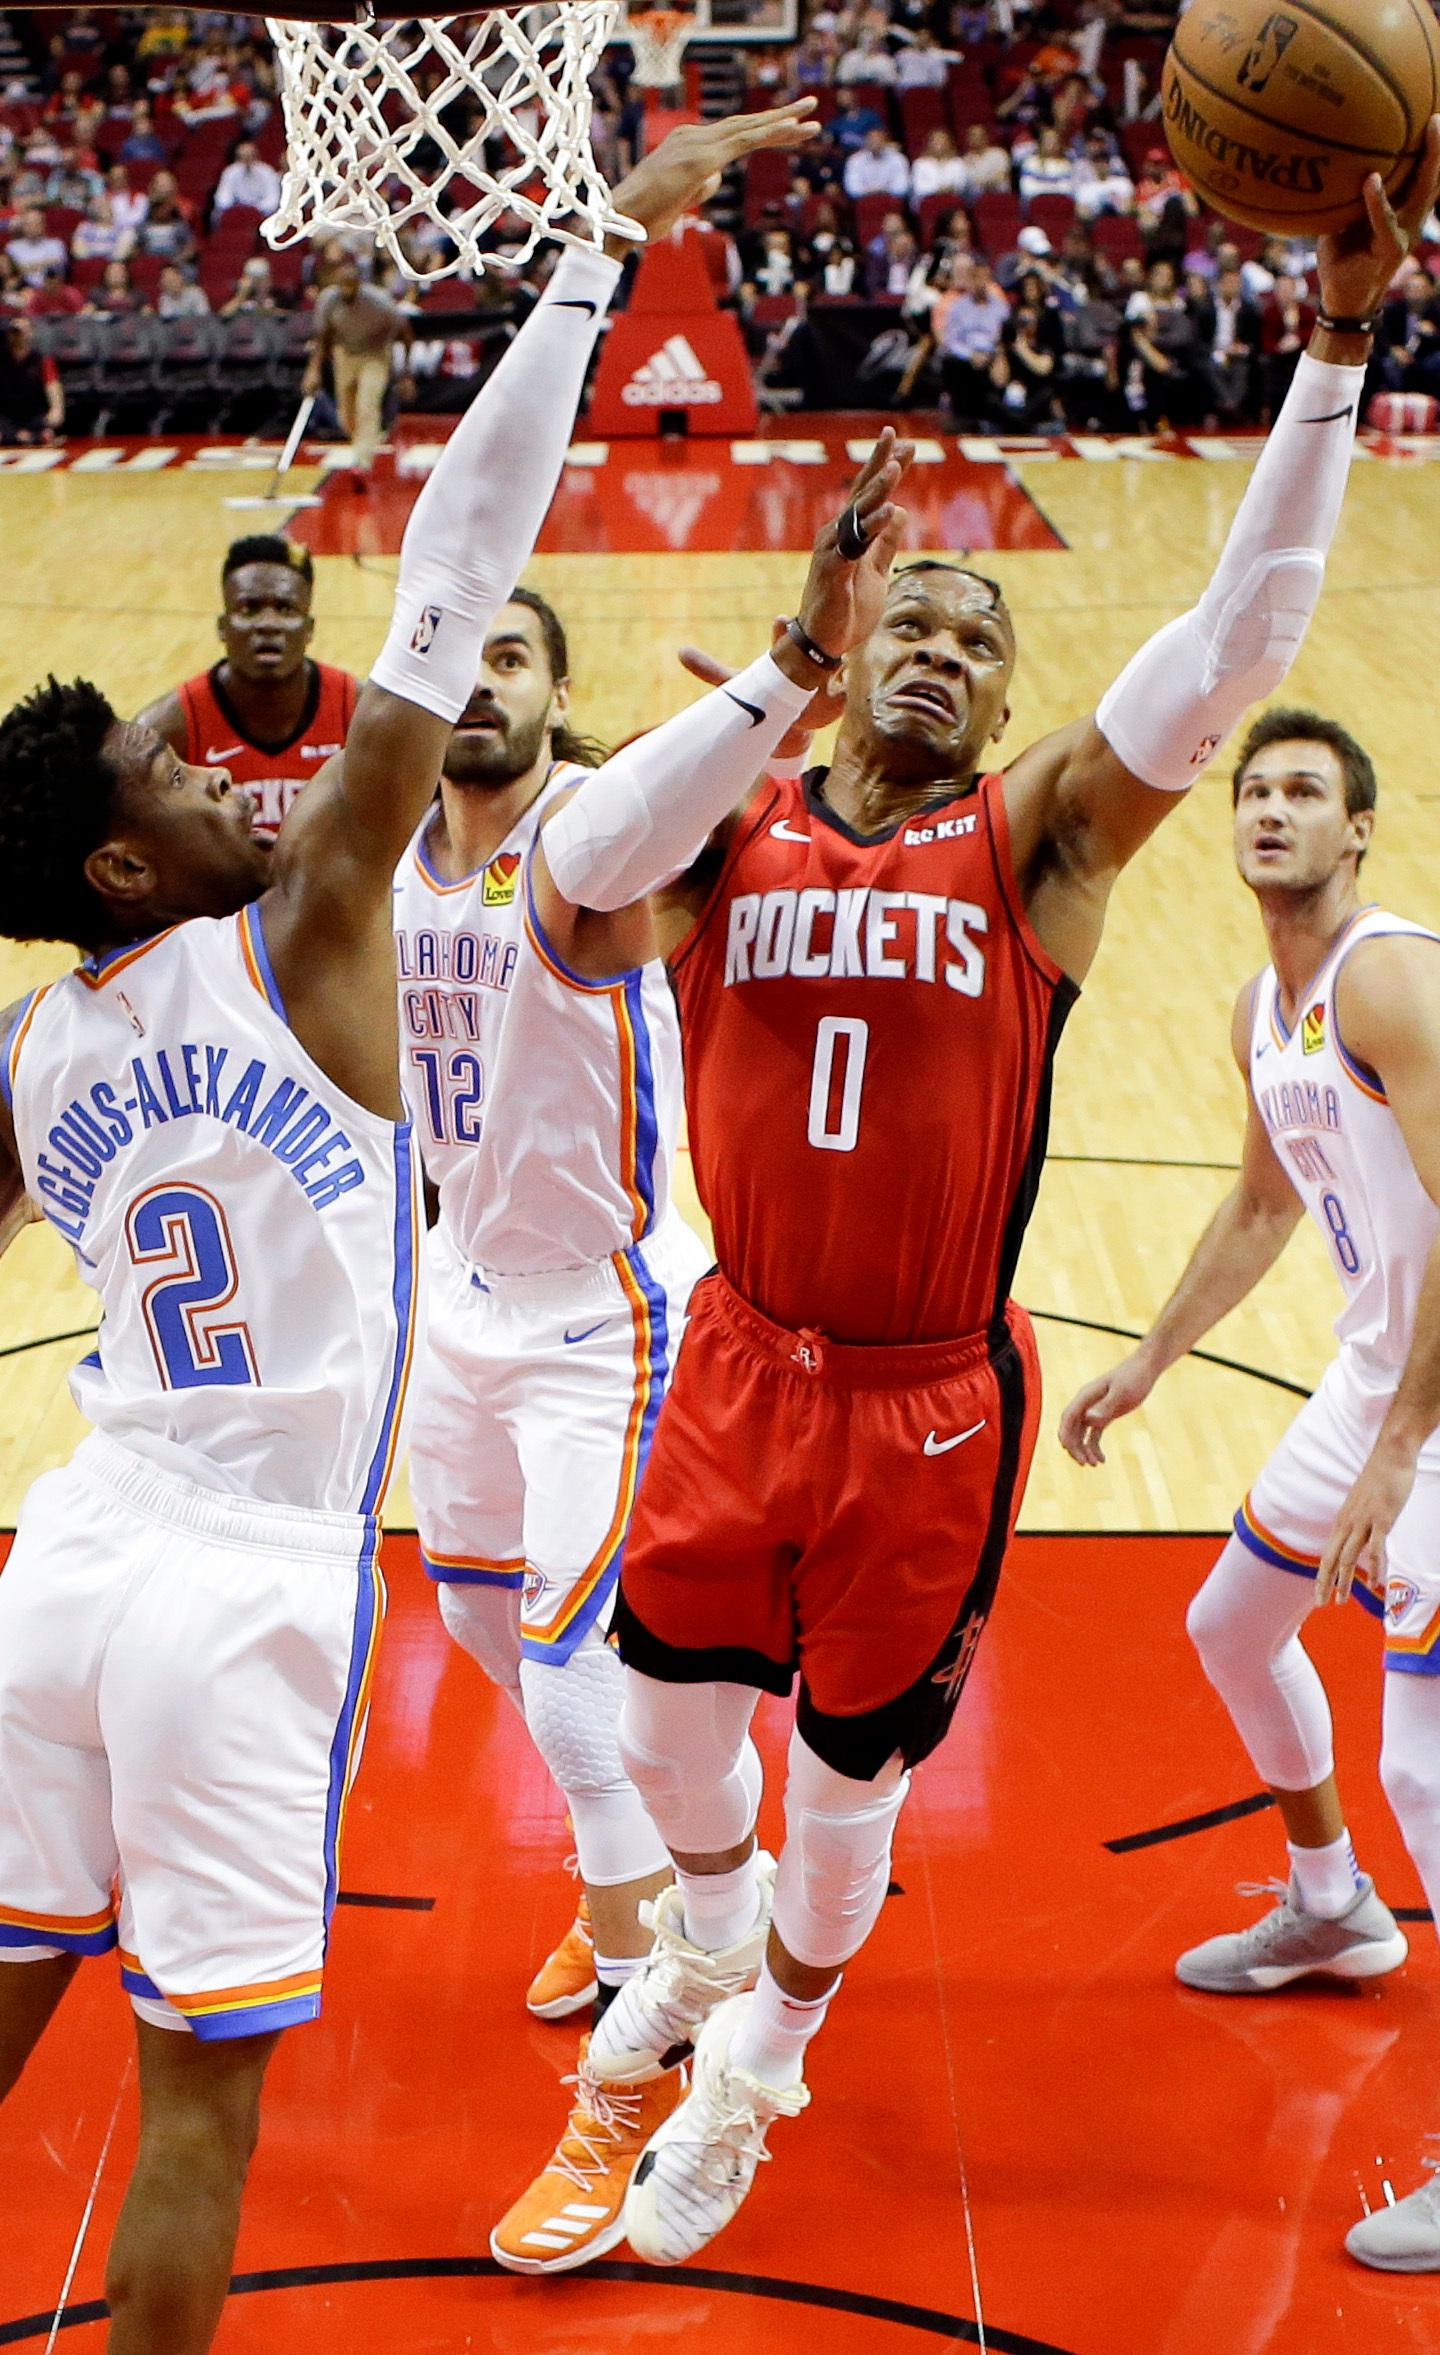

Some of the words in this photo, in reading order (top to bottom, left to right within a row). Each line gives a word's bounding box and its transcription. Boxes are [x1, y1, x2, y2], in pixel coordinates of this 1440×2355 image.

[1166, 75, 1331, 194] SPALDING
[621, 379, 723, 406] adidas
[395, 928, 519, 993] LAHOMA
[723, 885, 989, 998] ROCKETS
[404, 988, 480, 1042] CITY
[410, 1047, 484, 1148] 12
[807, 1015, 869, 1152] 0
[37, 1044, 366, 1241] LGEOUS-ALEXANDER
[125, 1181, 262, 1391] 2
[1319, 1187, 1362, 1280] 8
